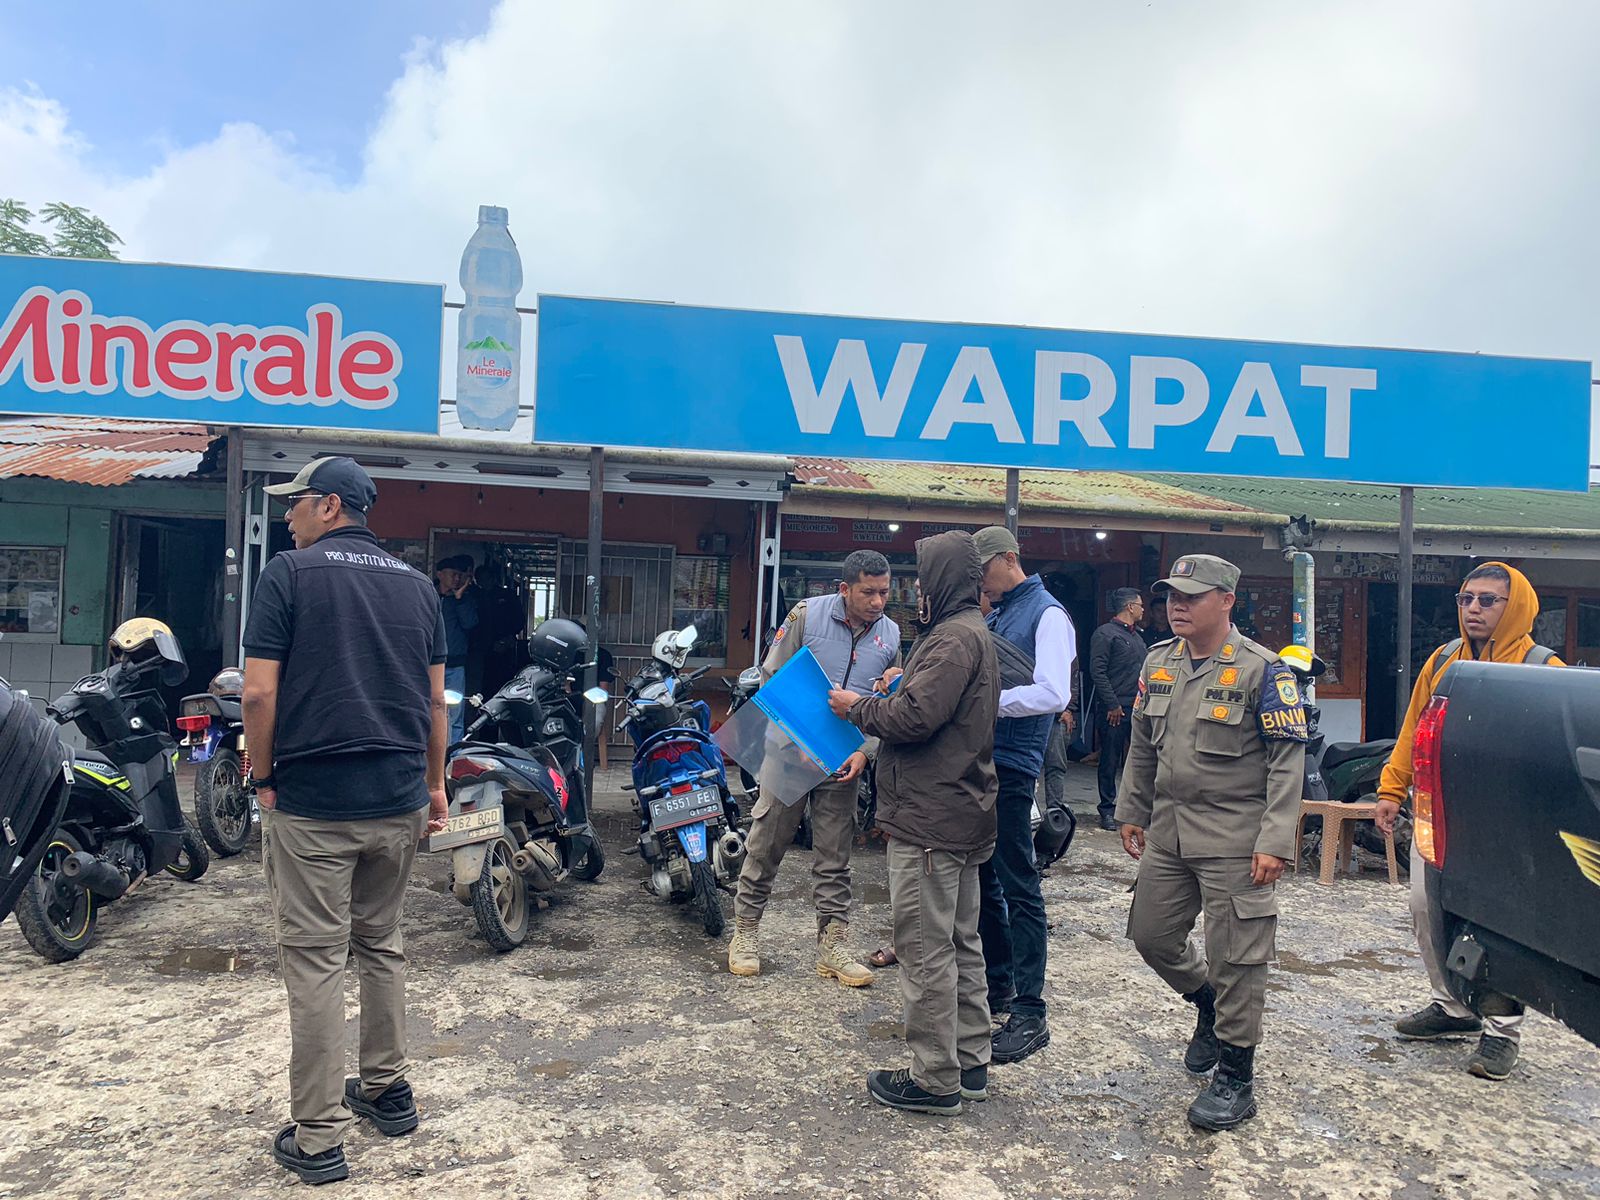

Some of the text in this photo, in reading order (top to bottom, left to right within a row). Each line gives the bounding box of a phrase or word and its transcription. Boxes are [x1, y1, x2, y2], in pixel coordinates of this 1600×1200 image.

[482, 356, 496, 367] Le
[466, 365, 512, 378] Minerale
[773, 335, 1377, 459] WARPAT
[325, 551, 345, 561] PRO
[1205, 689, 1243, 702] POL PP
[666, 797, 691, 812] 6551
[696, 790, 716, 804] FEV
